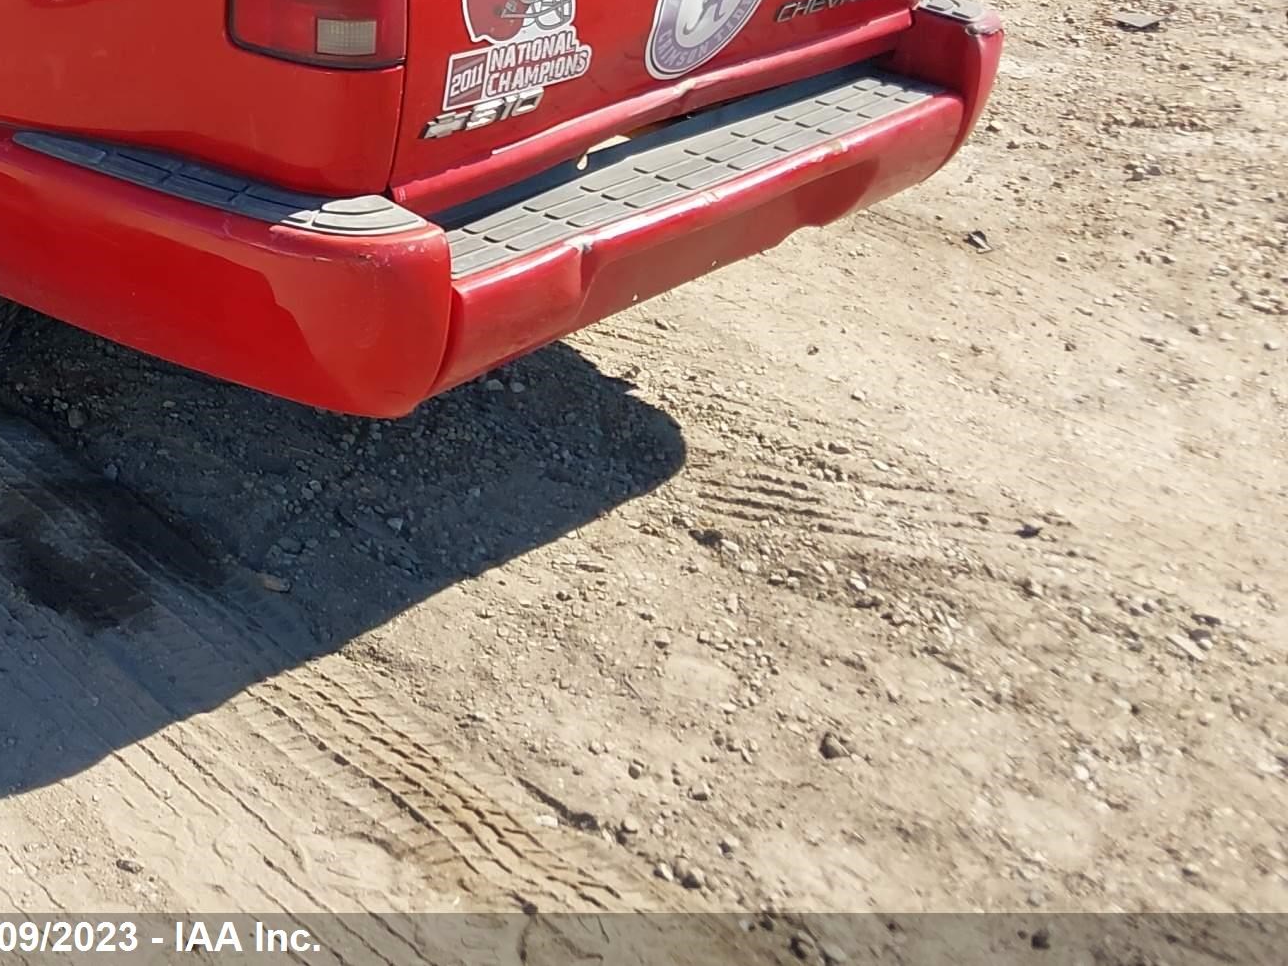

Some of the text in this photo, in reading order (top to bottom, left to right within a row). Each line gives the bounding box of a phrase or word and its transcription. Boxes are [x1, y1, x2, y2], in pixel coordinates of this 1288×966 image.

[485, 49, 589, 98] CHAMPIONS
[489, 33, 577, 73] NATIONAL
[449, 61, 485, 98] 2011
[465, 86, 545, 132] S10
